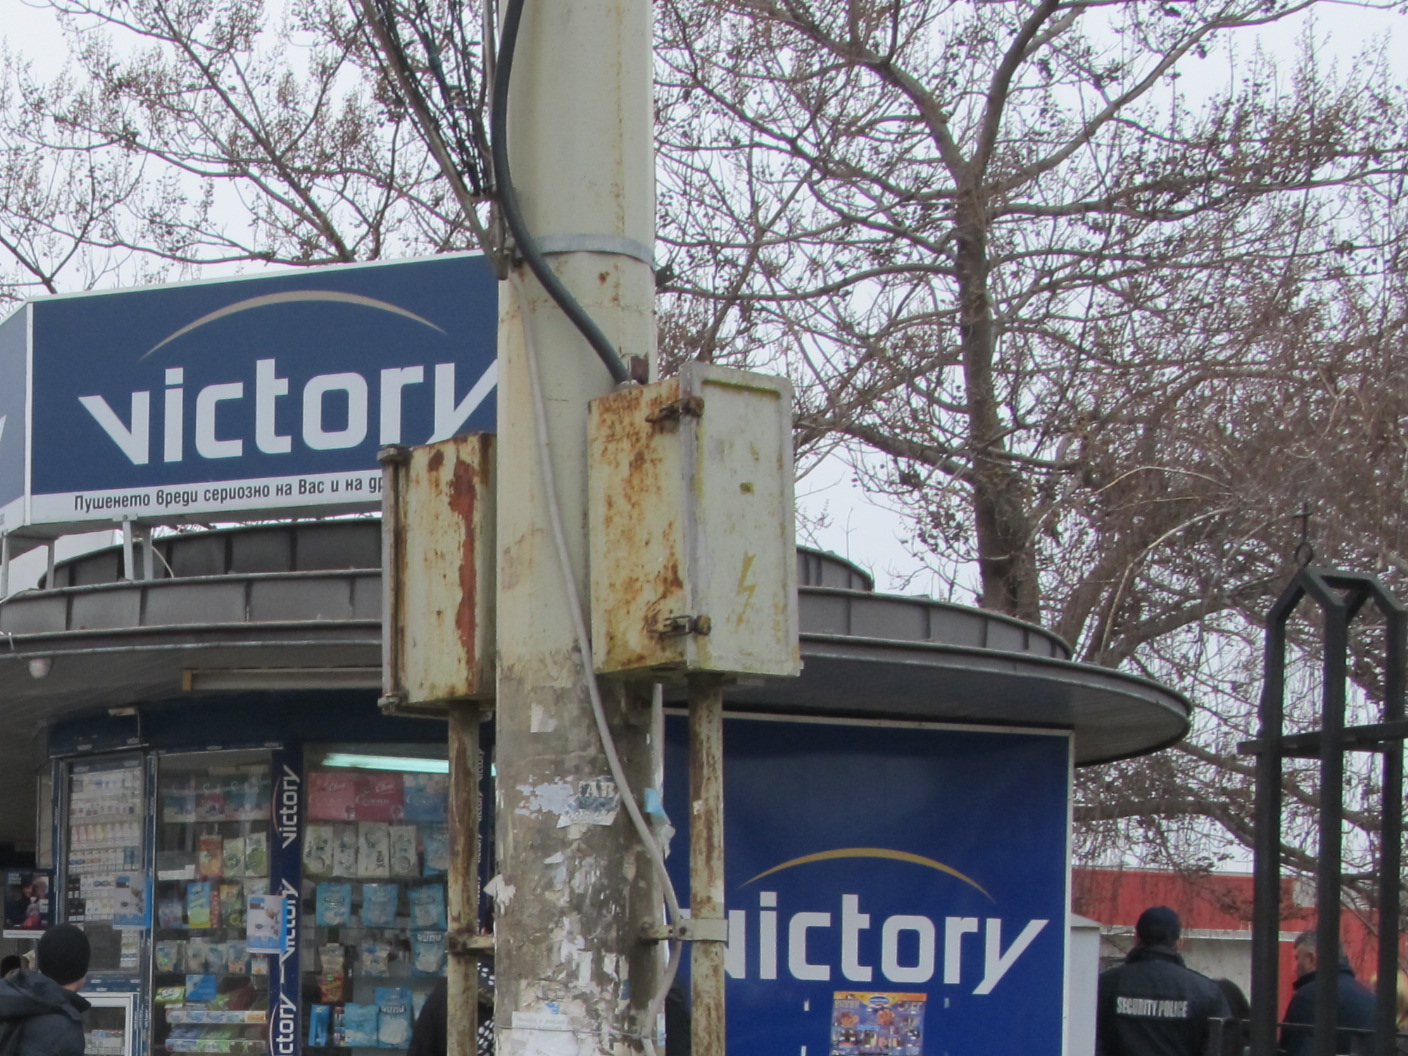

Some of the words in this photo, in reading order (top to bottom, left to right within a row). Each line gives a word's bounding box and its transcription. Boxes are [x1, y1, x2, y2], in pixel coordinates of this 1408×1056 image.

[77, 358, 498, 465] victory
[74, 494, 150, 513] Пушенето
[156, 490, 198, 508] вреди
[203, 482, 270, 503] сериозно
[276, 481, 292, 497] на
[298, 478, 325, 494] Вас
[331, 479, 339, 492] и
[345, 478, 363, 491] на
[279, 764, 301, 849] victory
[678, 891, 1050, 995] victory
[1116, 996, 1157, 1017] SECURITY
[1158, 1000, 1189, 1018] POLICE
